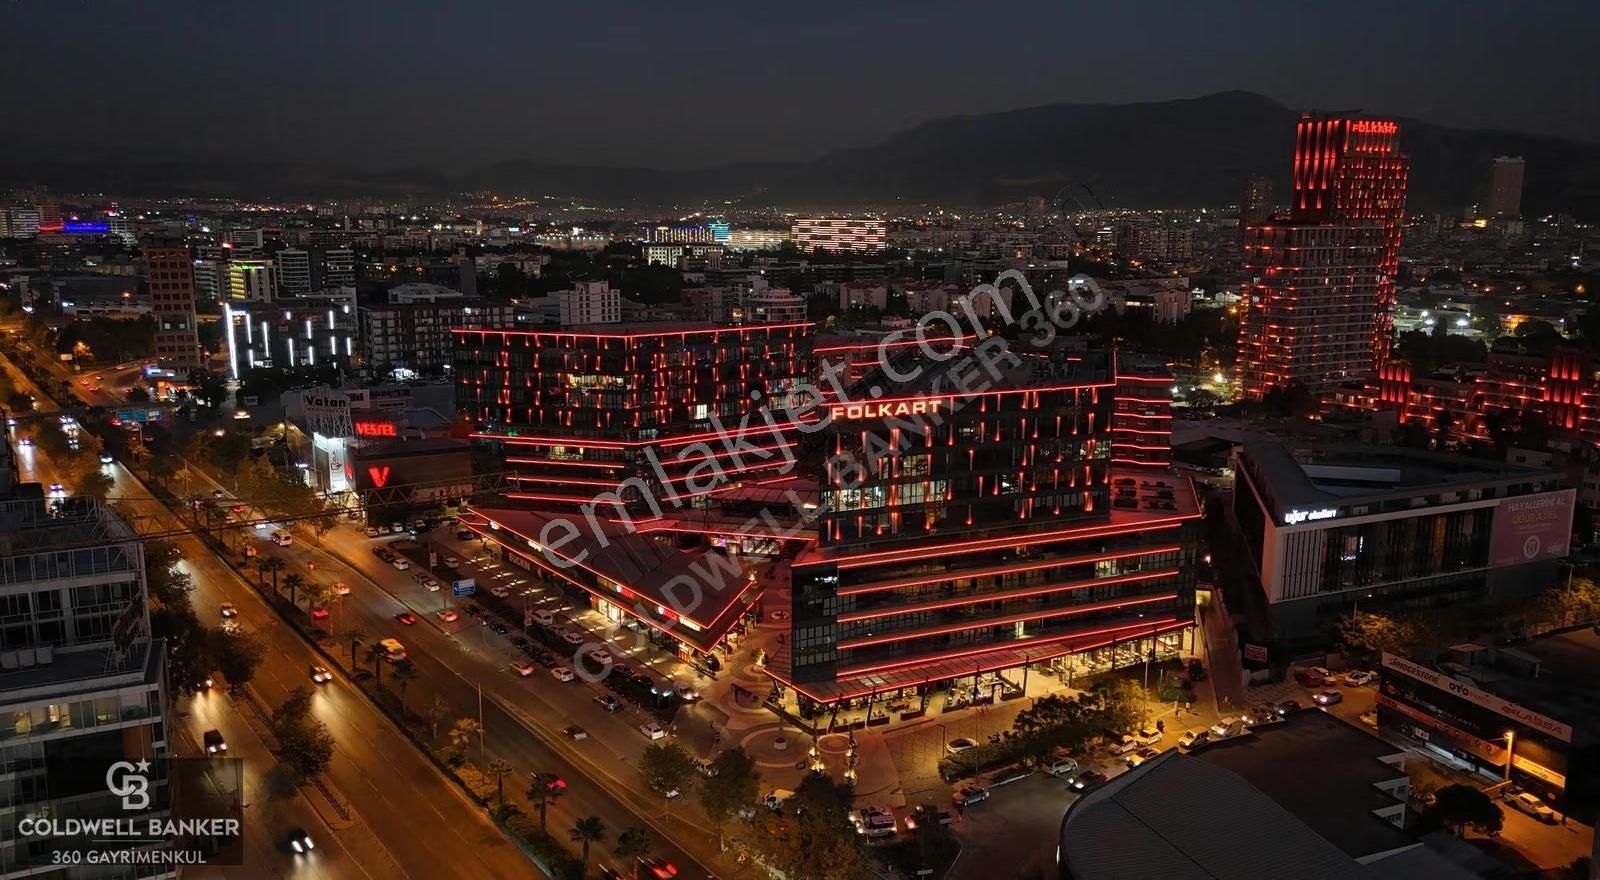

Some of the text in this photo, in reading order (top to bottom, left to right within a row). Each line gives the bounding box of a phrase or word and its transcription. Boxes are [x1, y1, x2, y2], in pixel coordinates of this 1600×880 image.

[1352, 121, 1398, 134] FOLKART
[305, 395, 346, 407] Vatan
[831, 400, 942, 421] FOLKART
[354, 420, 398, 437] VESTEL
[1284, 509, 1309, 525] uğur
